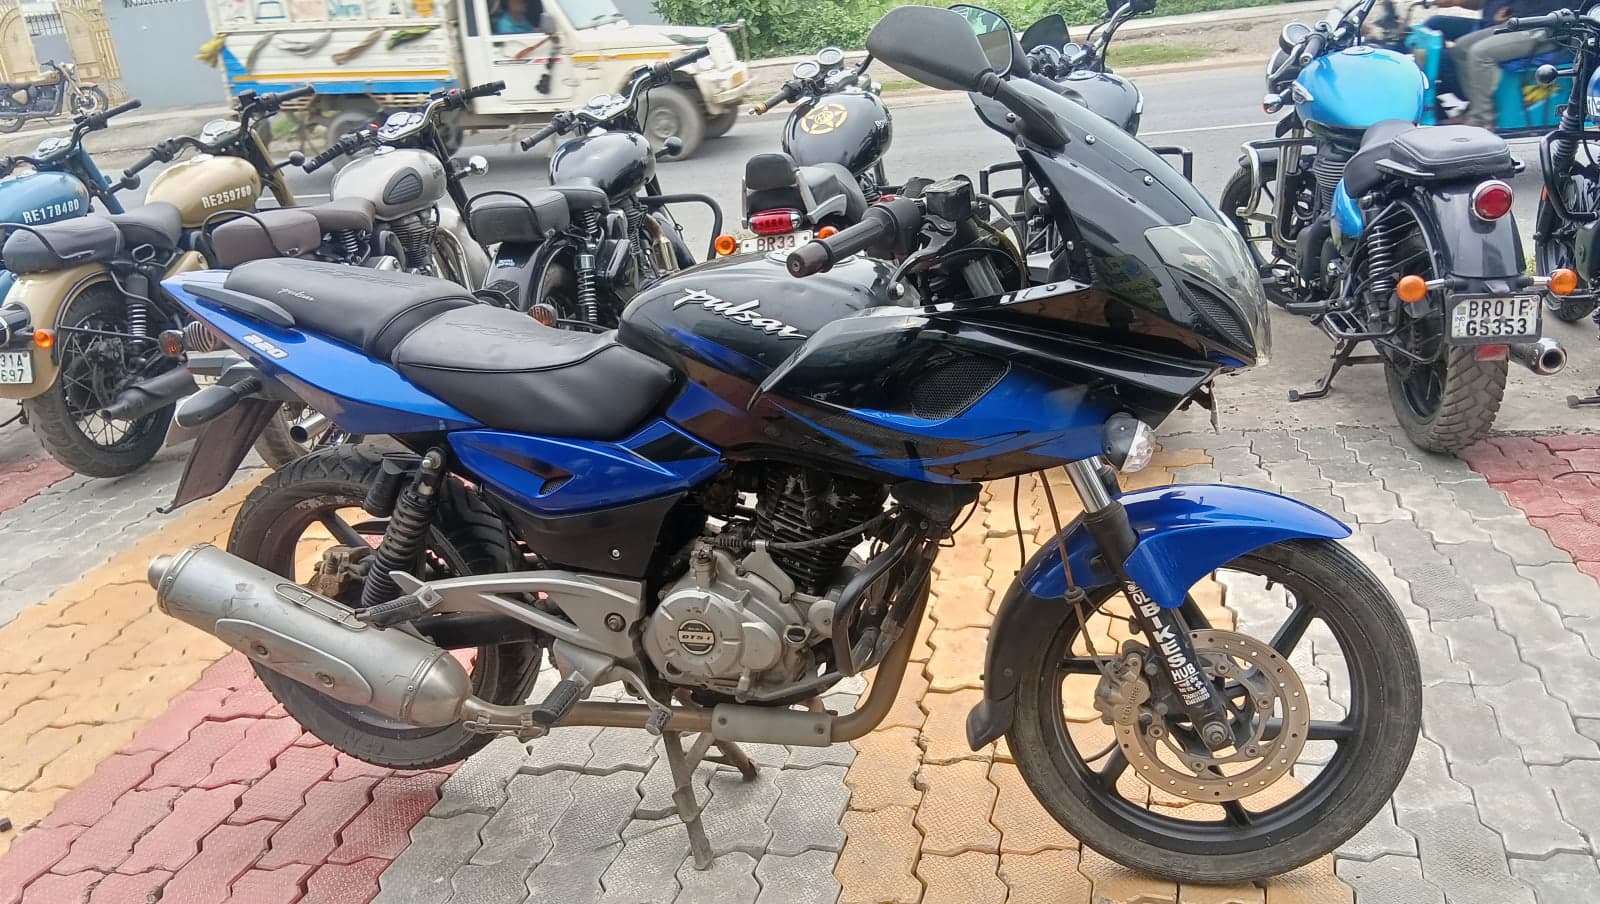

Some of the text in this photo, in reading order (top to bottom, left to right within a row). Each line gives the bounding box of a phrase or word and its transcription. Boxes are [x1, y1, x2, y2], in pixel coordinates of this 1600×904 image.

[757, 235, 796, 251] BR33
[242, 334, 289, 359] 220
[1140, 602, 1187, 668] BIKES
[1171, 662, 1196, 681] HUB
